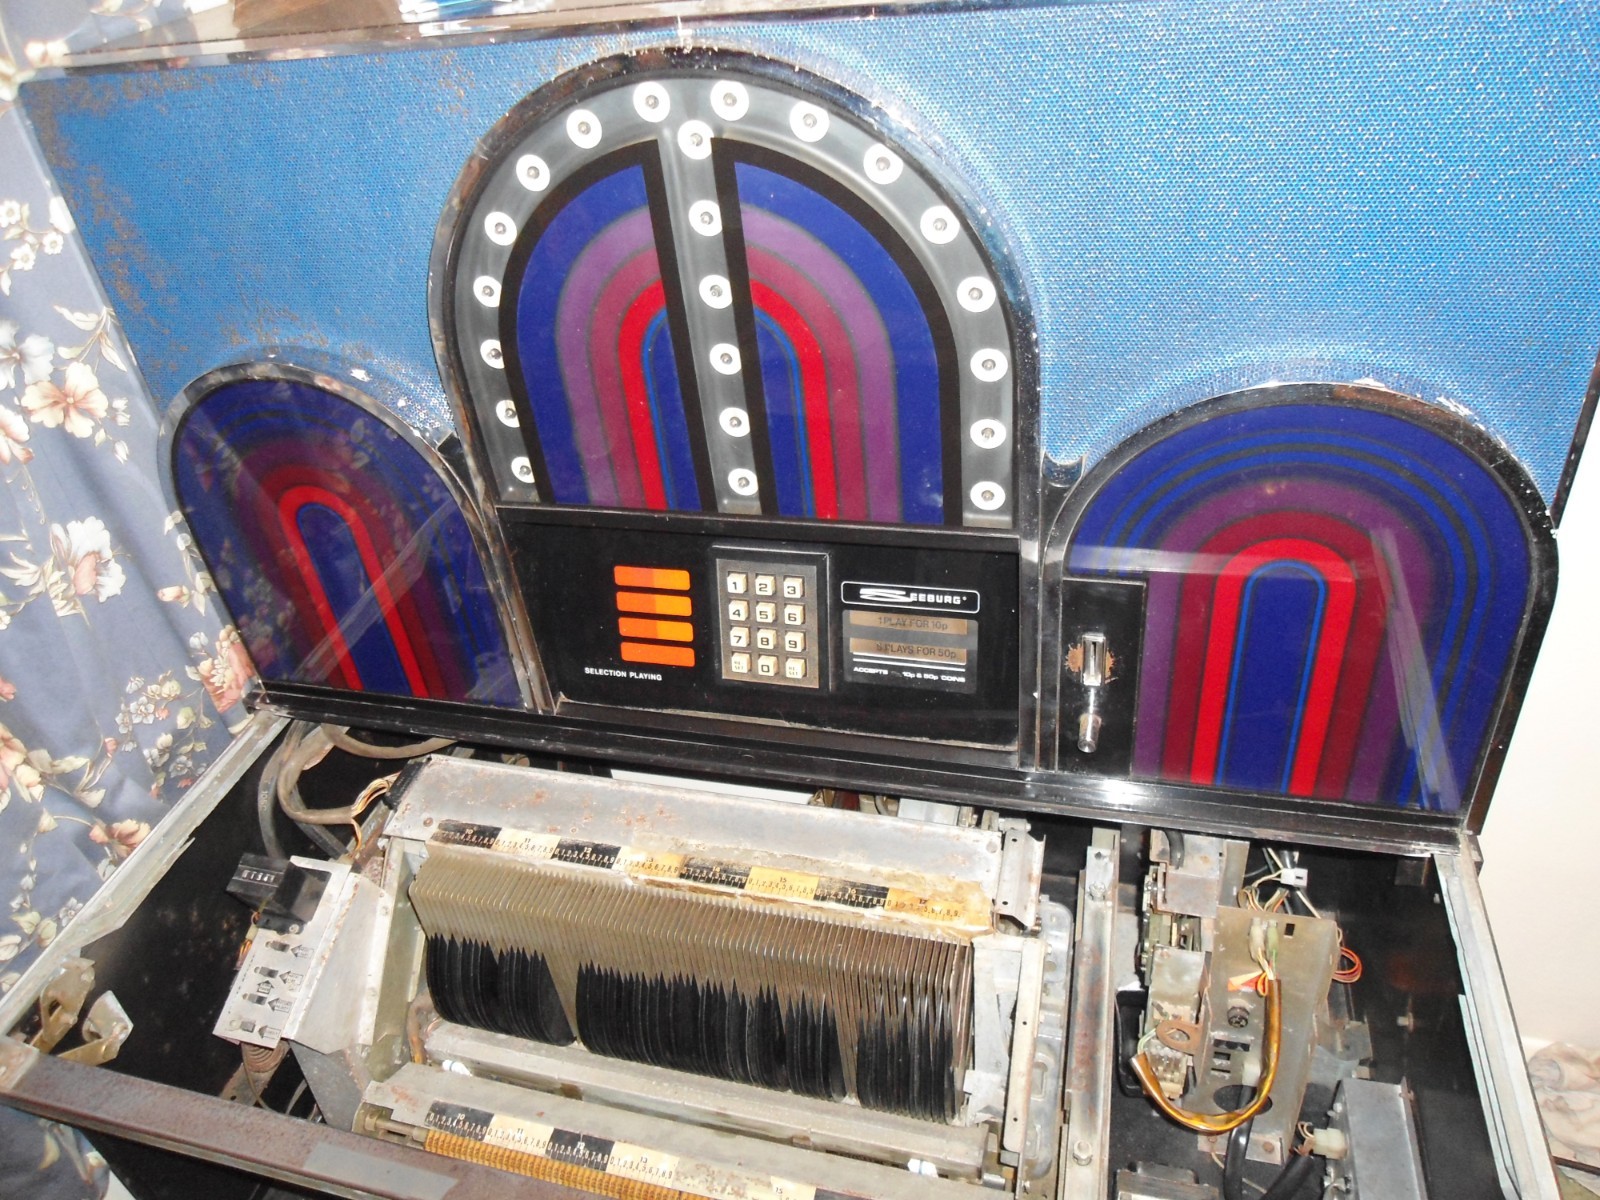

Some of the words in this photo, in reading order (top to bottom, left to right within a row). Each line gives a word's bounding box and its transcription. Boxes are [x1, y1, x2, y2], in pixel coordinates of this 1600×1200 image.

[732, 582, 737, 590] 1
[759, 583, 768, 592] 2
[787, 586, 796, 594] 3
[859, 588, 961, 605] SEEBURG
[732, 609, 741, 617] 4
[759, 611, 769, 620] 5
[788, 613, 797, 622] 6
[883, 617, 907, 627] PLAY
[909, 619, 929, 628] FOR
[931, 620, 948, 630] 10p
[733, 635, 742, 644] 7
[760, 637, 770, 646] 8
[788, 640, 798, 649] 9
[885, 644, 914, 654] PLAYS
[916, 647, 936, 656] FOR
[938, 648, 957, 659] 50p
[761, 664, 770, 673] 0
[584, 667, 627, 678] SELECTION
[629, 671, 663, 681] PLAYING
[853, 667, 889, 675] ACCEPTS
[940, 675, 966, 683] COINS
